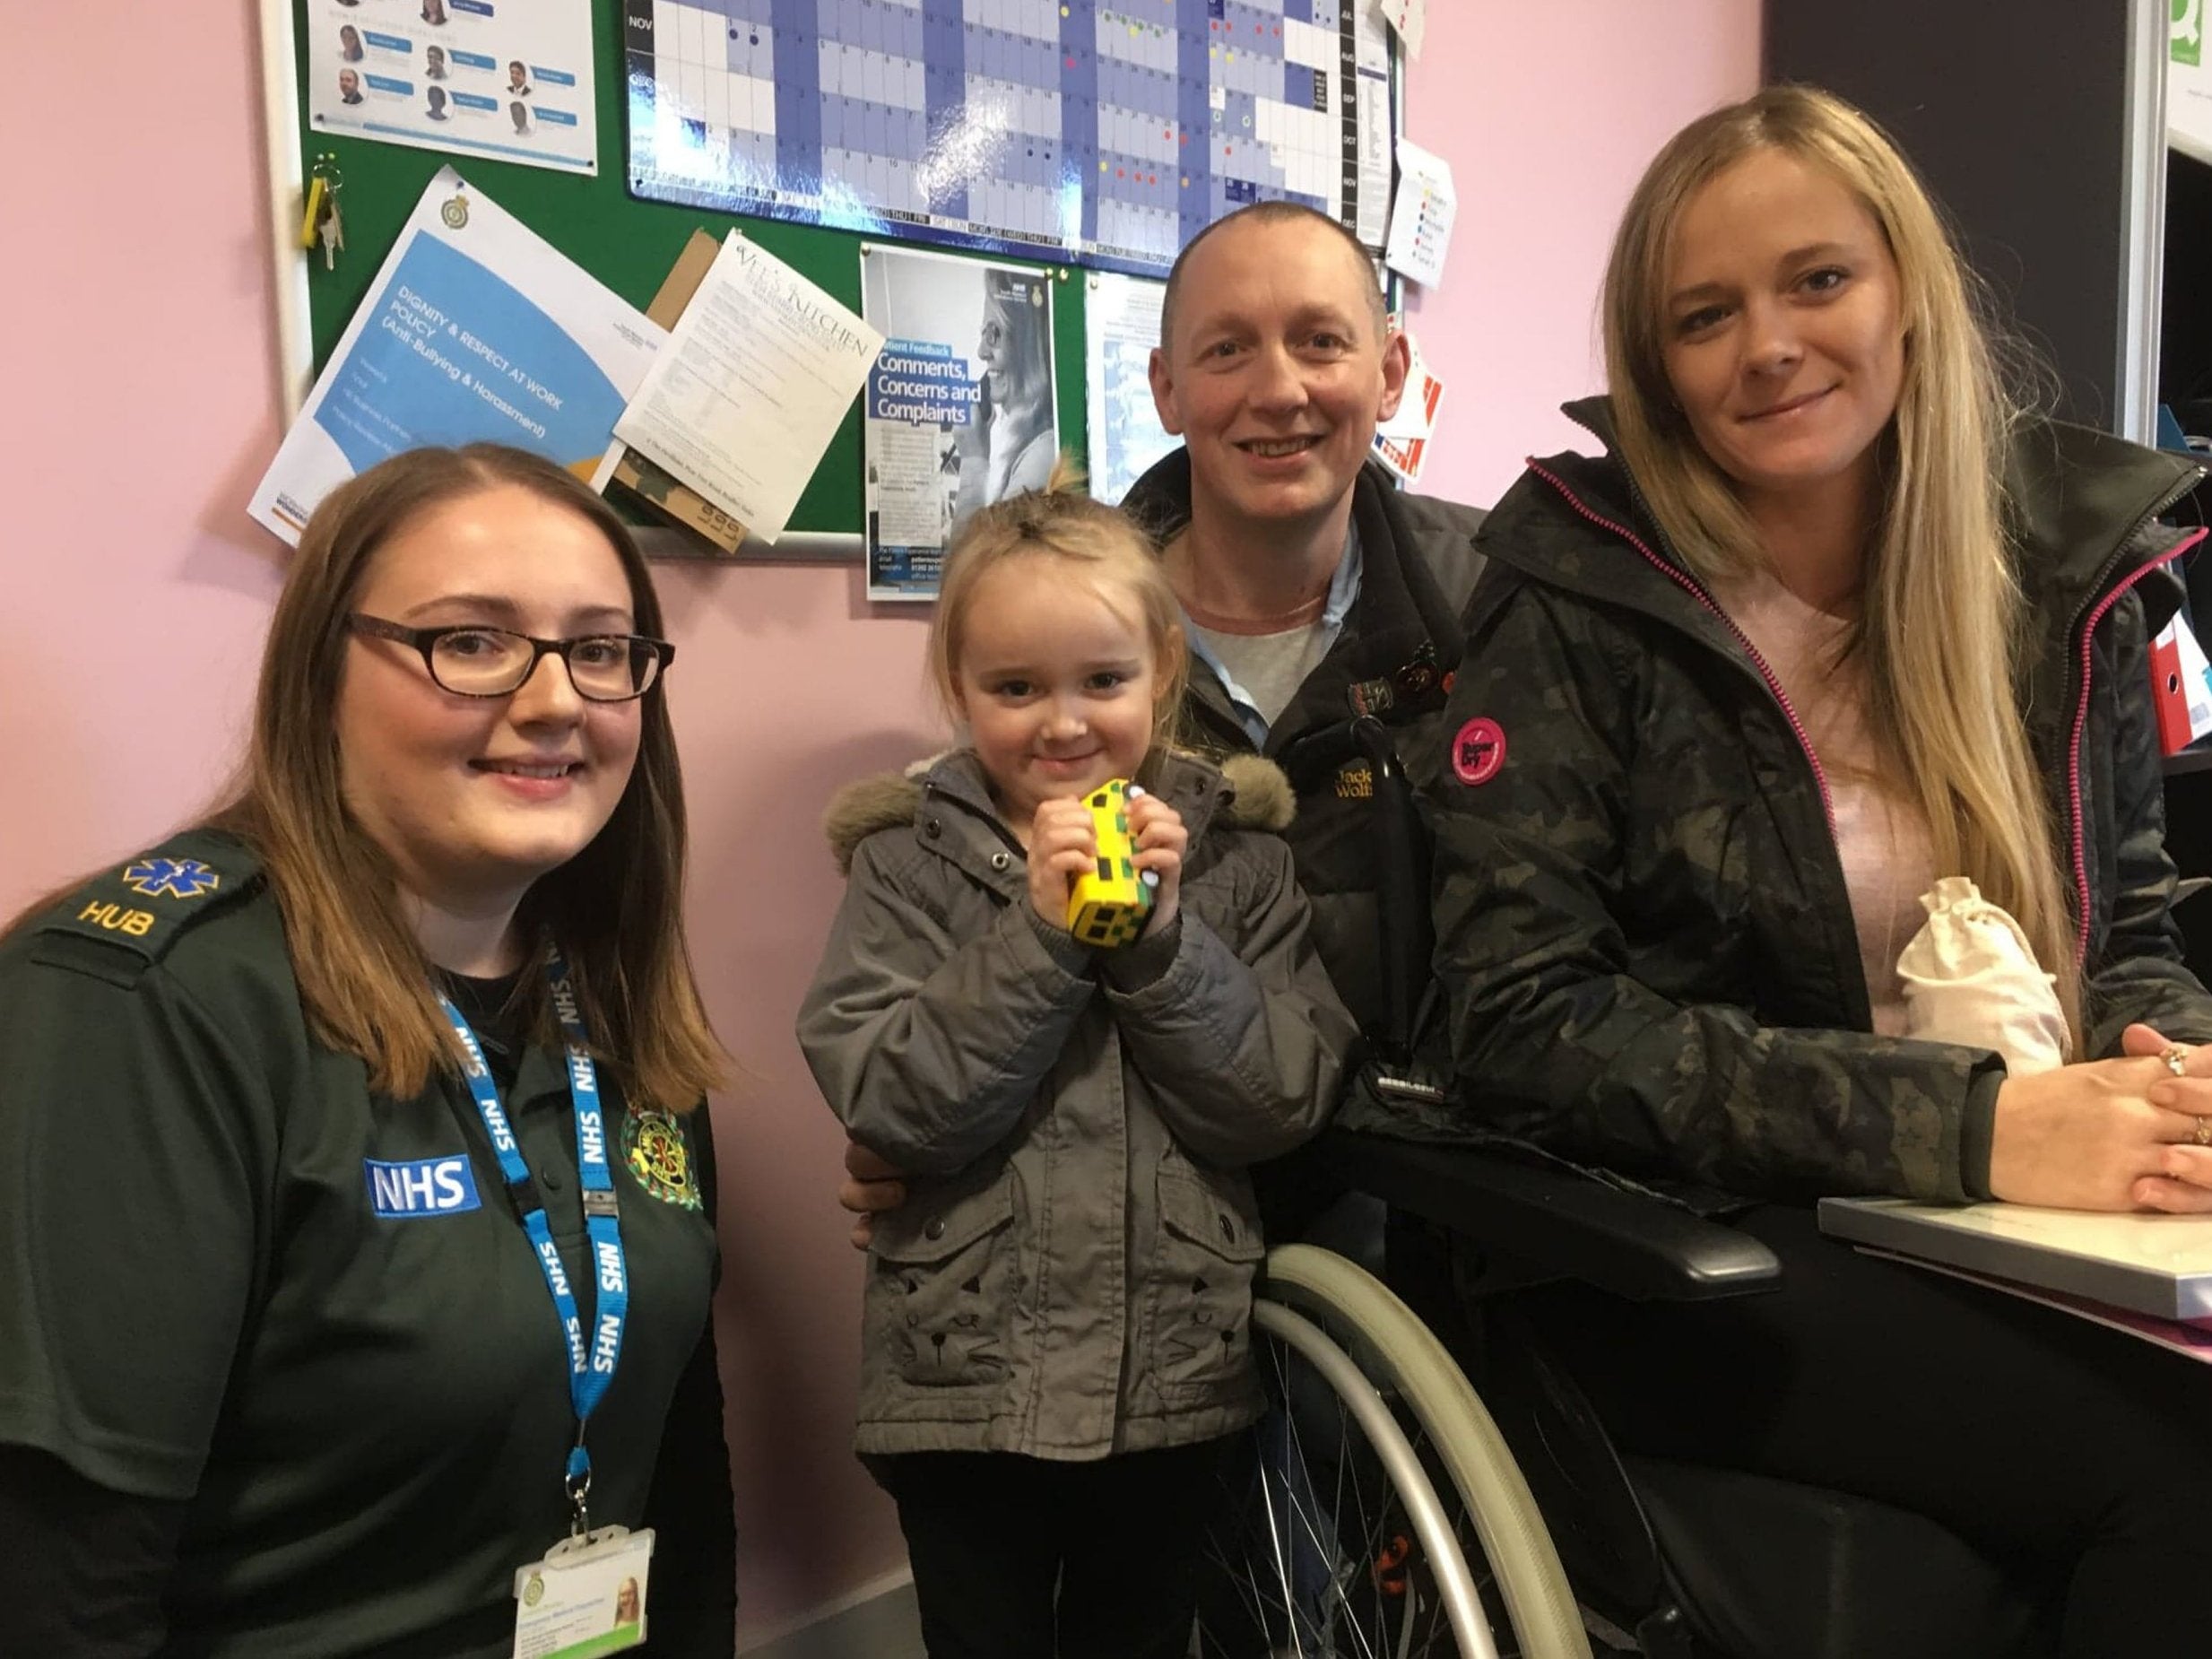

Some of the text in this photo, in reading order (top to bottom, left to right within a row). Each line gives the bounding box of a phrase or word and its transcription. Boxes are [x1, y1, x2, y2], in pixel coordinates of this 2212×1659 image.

[629, 15, 653, 30] NOV
[751, 23, 757, 32] 2
[1343, 136, 1356, 145] OCT
[390, 300, 437, 337] POLICY
[788, 286, 869, 357] KITCHEN
[397, 285, 563, 411] DIGNITY & RESPECT AT WORK
[878, 352, 967, 381] Comments,
[909, 343, 950, 357] Feedback
[462, 373, 472, 387] &
[473, 380, 545, 439] Harassment)
[878, 375, 982, 403] Concerns and
[878, 398, 967, 424] Complaints
[77, 900, 155, 936] HUB
[551, 979, 581, 1024] NHS
[568, 1043, 594, 1091] NHS
[481, 1099, 516, 1152] NHS
[580, 1111, 604, 1163] NHS
[373, 1160, 464, 1212] NHS
[539, 1240, 570, 1296] NHS
[596, 1241, 623, 1293] NHS
[566, 1316, 588, 1374] NHS
[593, 1314, 621, 1374] NHS
